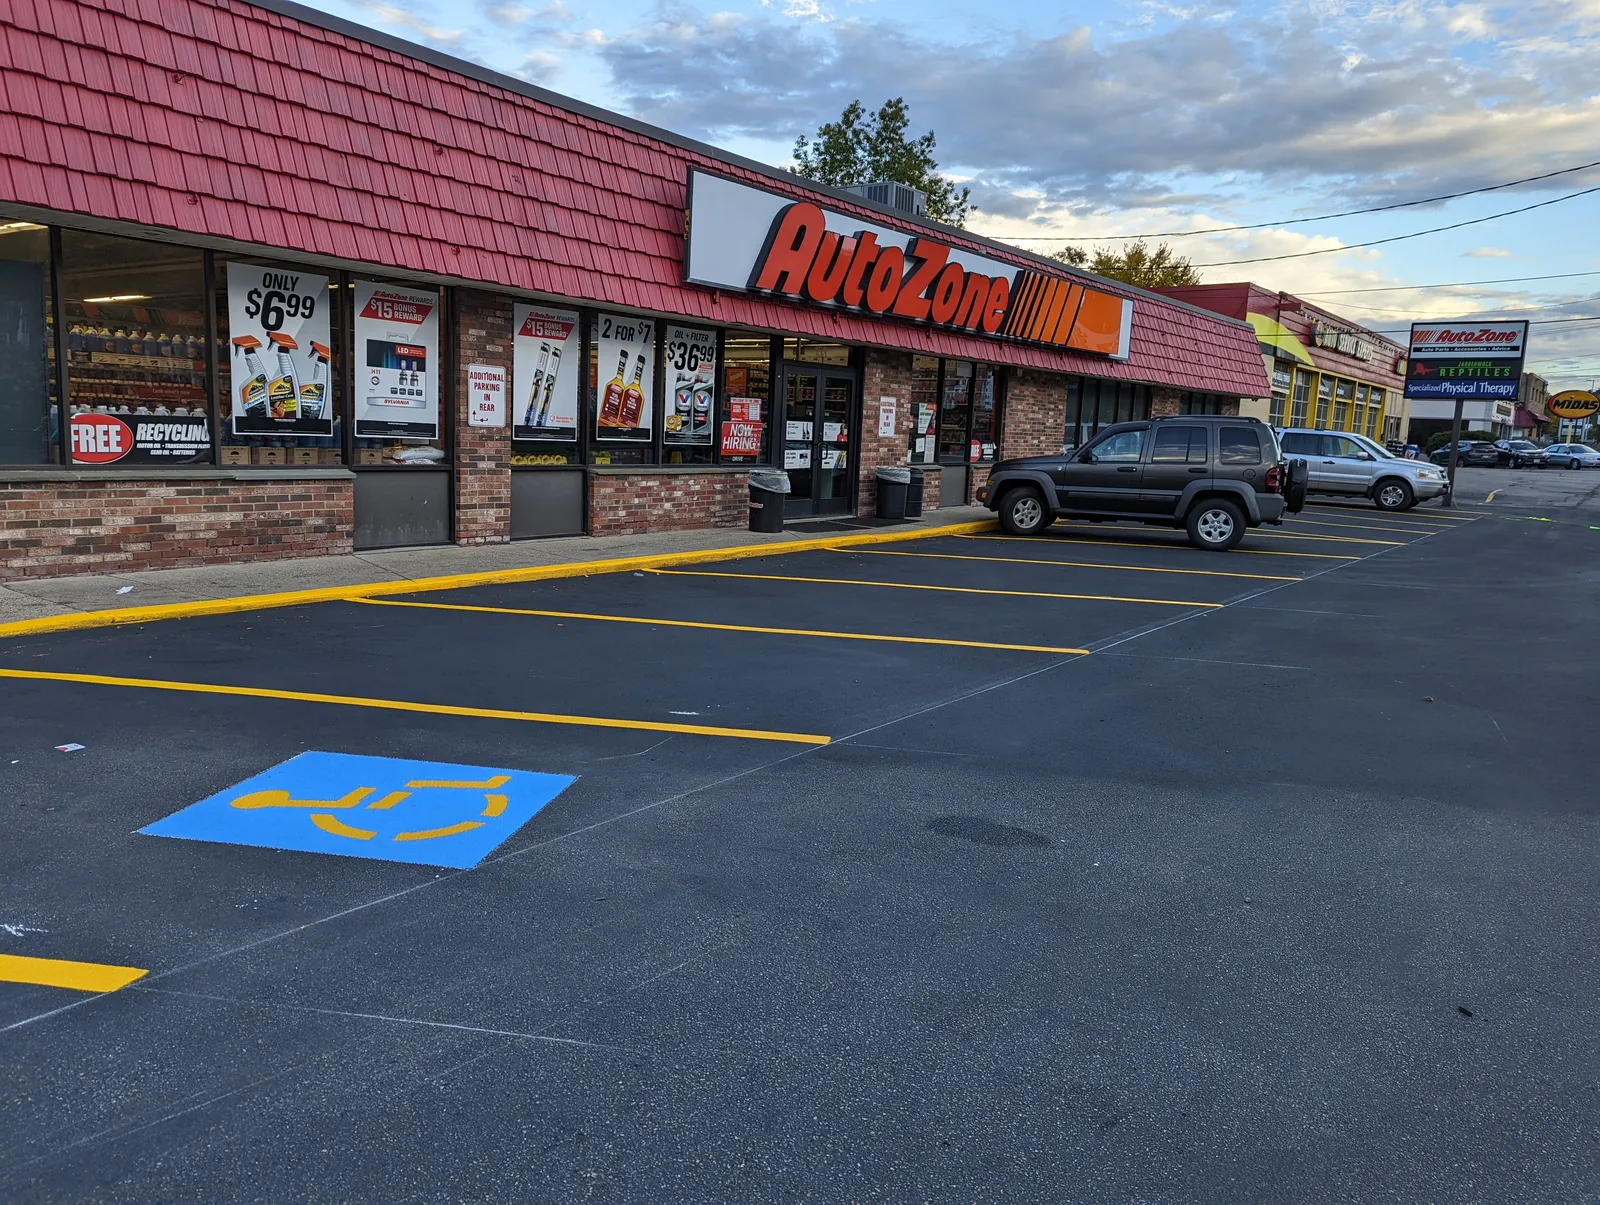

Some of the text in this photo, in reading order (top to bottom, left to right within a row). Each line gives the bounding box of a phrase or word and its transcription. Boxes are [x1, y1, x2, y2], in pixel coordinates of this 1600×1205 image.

[751, 202, 1010, 333] AutoZone
[262, 272, 300, 292] ONLY
[380, 292, 434, 304] AutoZone REWARDS
[370, 298, 392, 318] $15
[394, 303, 416, 313] BONUS
[526, 319, 544, 336] $15
[544, 322, 562, 330] BONUS
[602, 318, 652, 343] 2 FOR $7
[674, 330, 684, 339] OIL
[690, 332, 709, 342] FILTER
[1435, 328, 1518, 343] AutoZone
[470, 372, 504, 382] ADDITIONAL
[1440, 368, 1510, 377] REPTILES
[474, 382, 500, 392] PARKING
[1408, 382, 1516, 396] Specialized Physical Therapy
[480, 403, 495, 411] REAR
[1553, 398, 1598, 410] MIDAS
[136, 423, 210, 441] RECYCLING
[730, 424, 753, 436] NOW
[71, 424, 122, 453] FREE
[722, 437, 756, 450] HIRING
